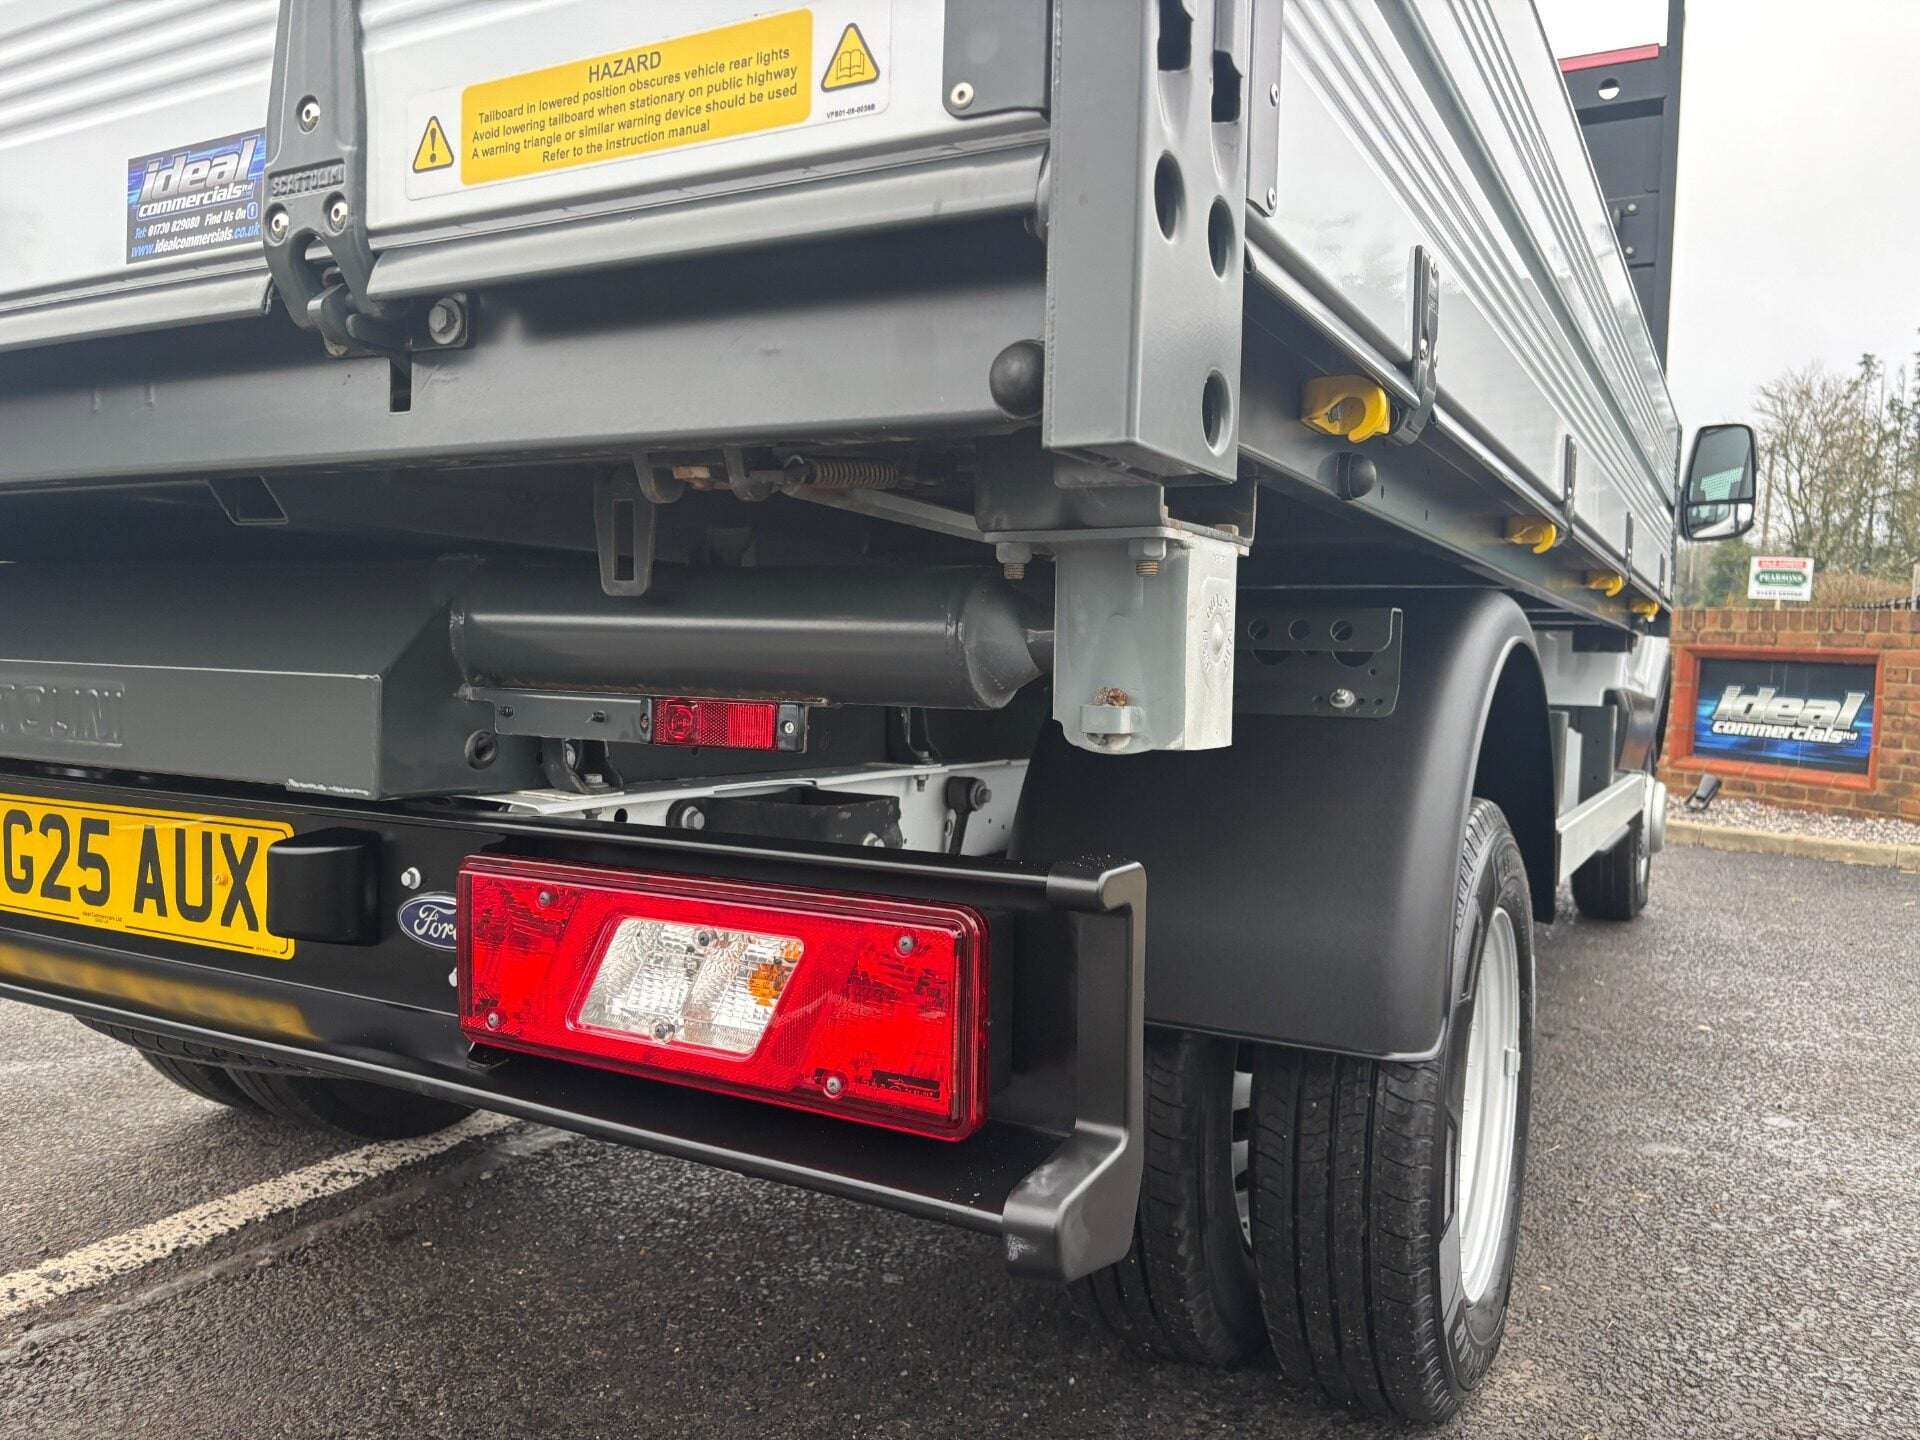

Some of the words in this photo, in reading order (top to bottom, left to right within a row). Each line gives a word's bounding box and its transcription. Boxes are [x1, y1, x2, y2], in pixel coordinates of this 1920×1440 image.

[479, 104, 523, 124] Tailboard
[526, 103, 536, 114] in
[539, 92, 579, 112] lowered
[582, 84, 626, 106] position
[629, 71, 681, 92] obscures
[684, 61, 725, 80] vehicle
[729, 55, 752, 71] rear
[756, 48, 790, 66] lights
[588, 51, 661, 83] HAZARD
[472, 127, 500, 143] Avoid
[503, 119, 545, 137] lowering
[549, 107, 594, 127] tailboard
[598, 102, 626, 117] when
[629, 88, 685, 110] stationary
[688, 86, 703, 97] on
[706, 77, 742, 96] public
[747, 66, 798, 87] highway
[472, 148, 479, 160] A
[481, 141, 521, 158] warning
[523, 131, 562, 148] triangle
[564, 129, 577, 141] or
[578, 122, 615, 138] similar
[617, 113, 661, 130] warning
[665, 103, 702, 121] device
[705, 93, 746, 113] should
[750, 91, 764, 104] be
[767, 83, 797, 100] used
[542, 149, 570, 162] Refer
[573, 145, 583, 157] to
[586, 141, 602, 155] the
[606, 131, 665, 151] instruction
[668, 119, 710, 139] manual
[138, 139, 257, 203] ideal
[139, 184, 243, 218] commercials
[148, 223, 171, 237] 01730
[204, 211, 222, 227] Find
[224, 209, 234, 223] Us
[235, 207, 246, 220] On
[131, 222, 260, 257] www.idealcommercials.co.uk
[1712, 685, 1866, 729] ideal
[1712, 721, 1843, 744] commercials
[2, 809, 111, 907] G25
[133, 825, 260, 933] AUX
[413, 904, 457, 941] For
